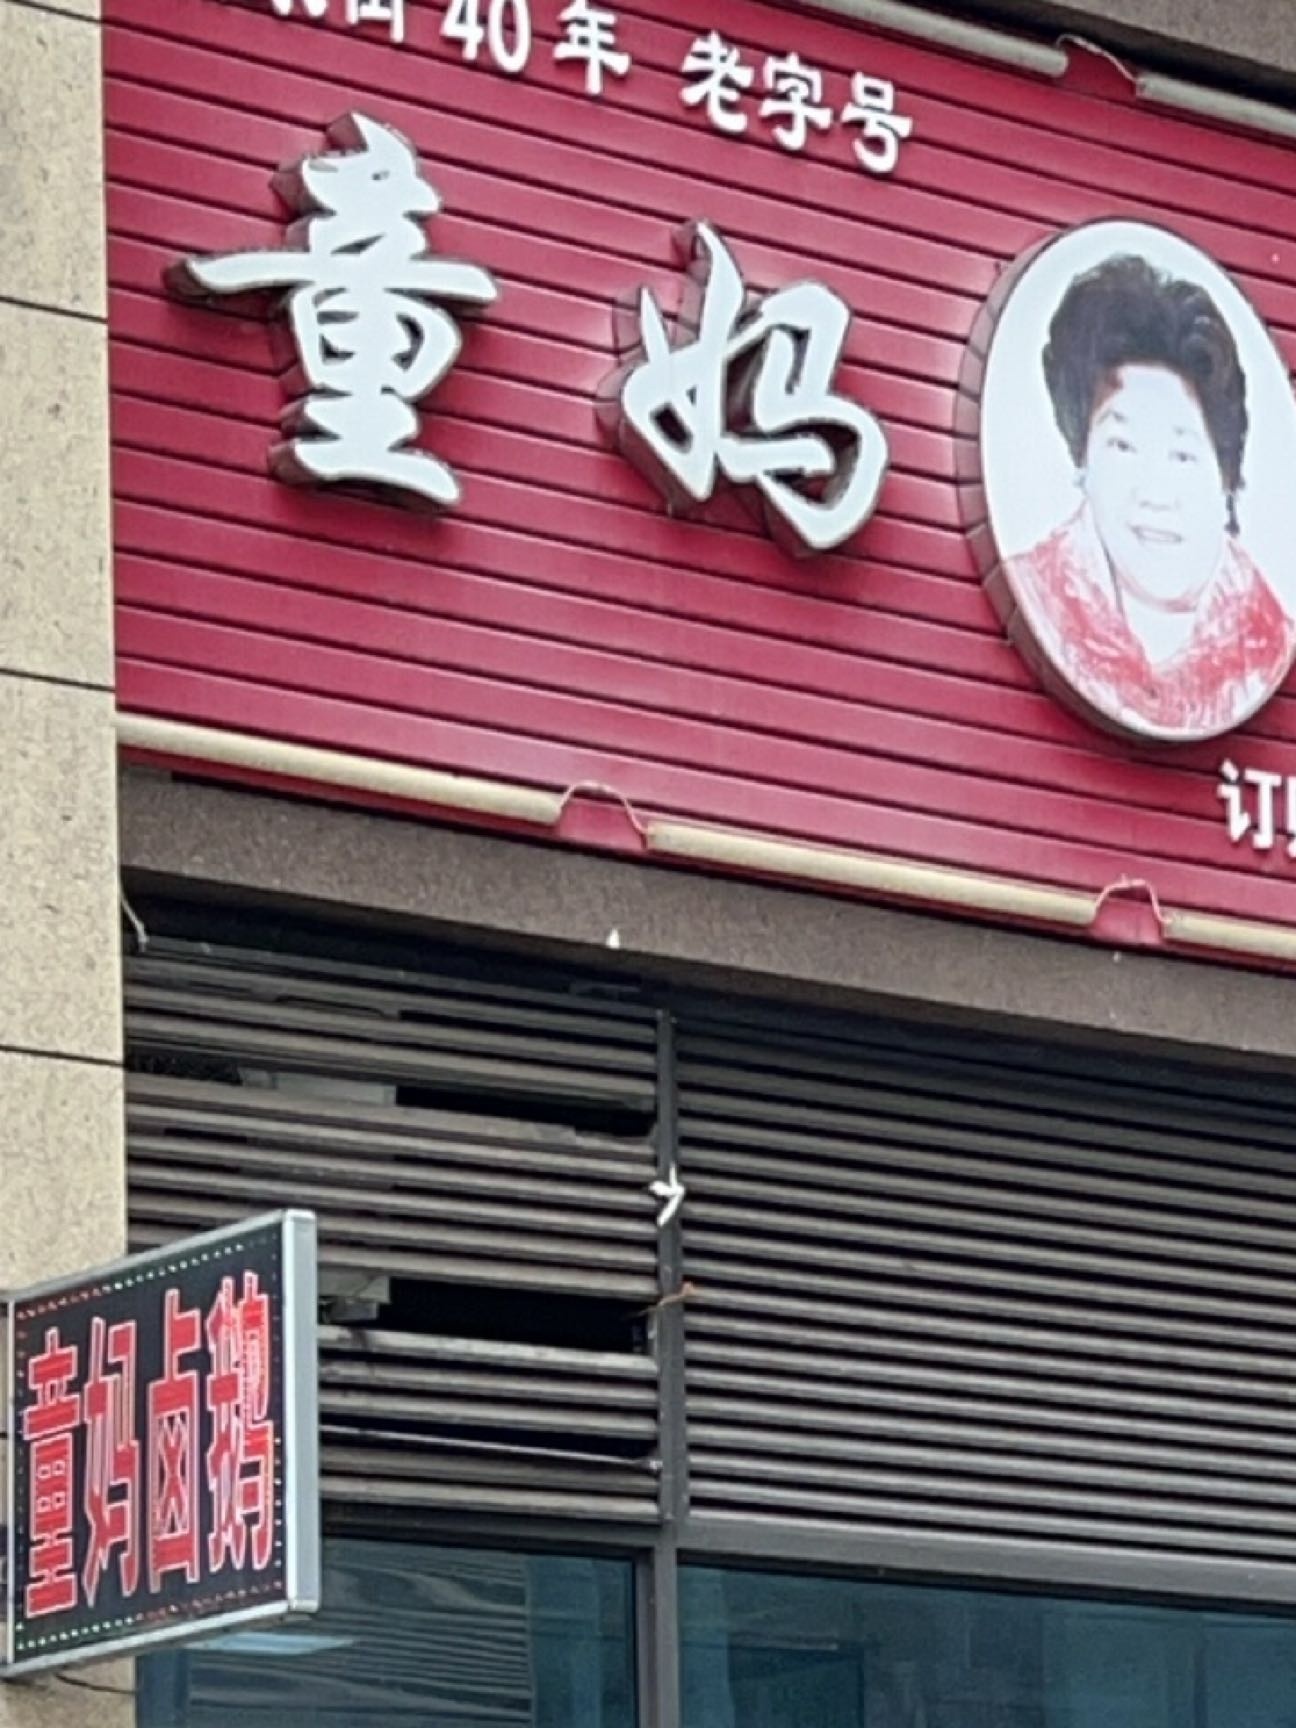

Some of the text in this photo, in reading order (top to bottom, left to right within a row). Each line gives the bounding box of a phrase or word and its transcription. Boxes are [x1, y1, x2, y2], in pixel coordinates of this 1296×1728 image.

[270, 0, 914, 174] 40年 老字号
[22, 1270, 274, 1619] 童妈卤鹅
